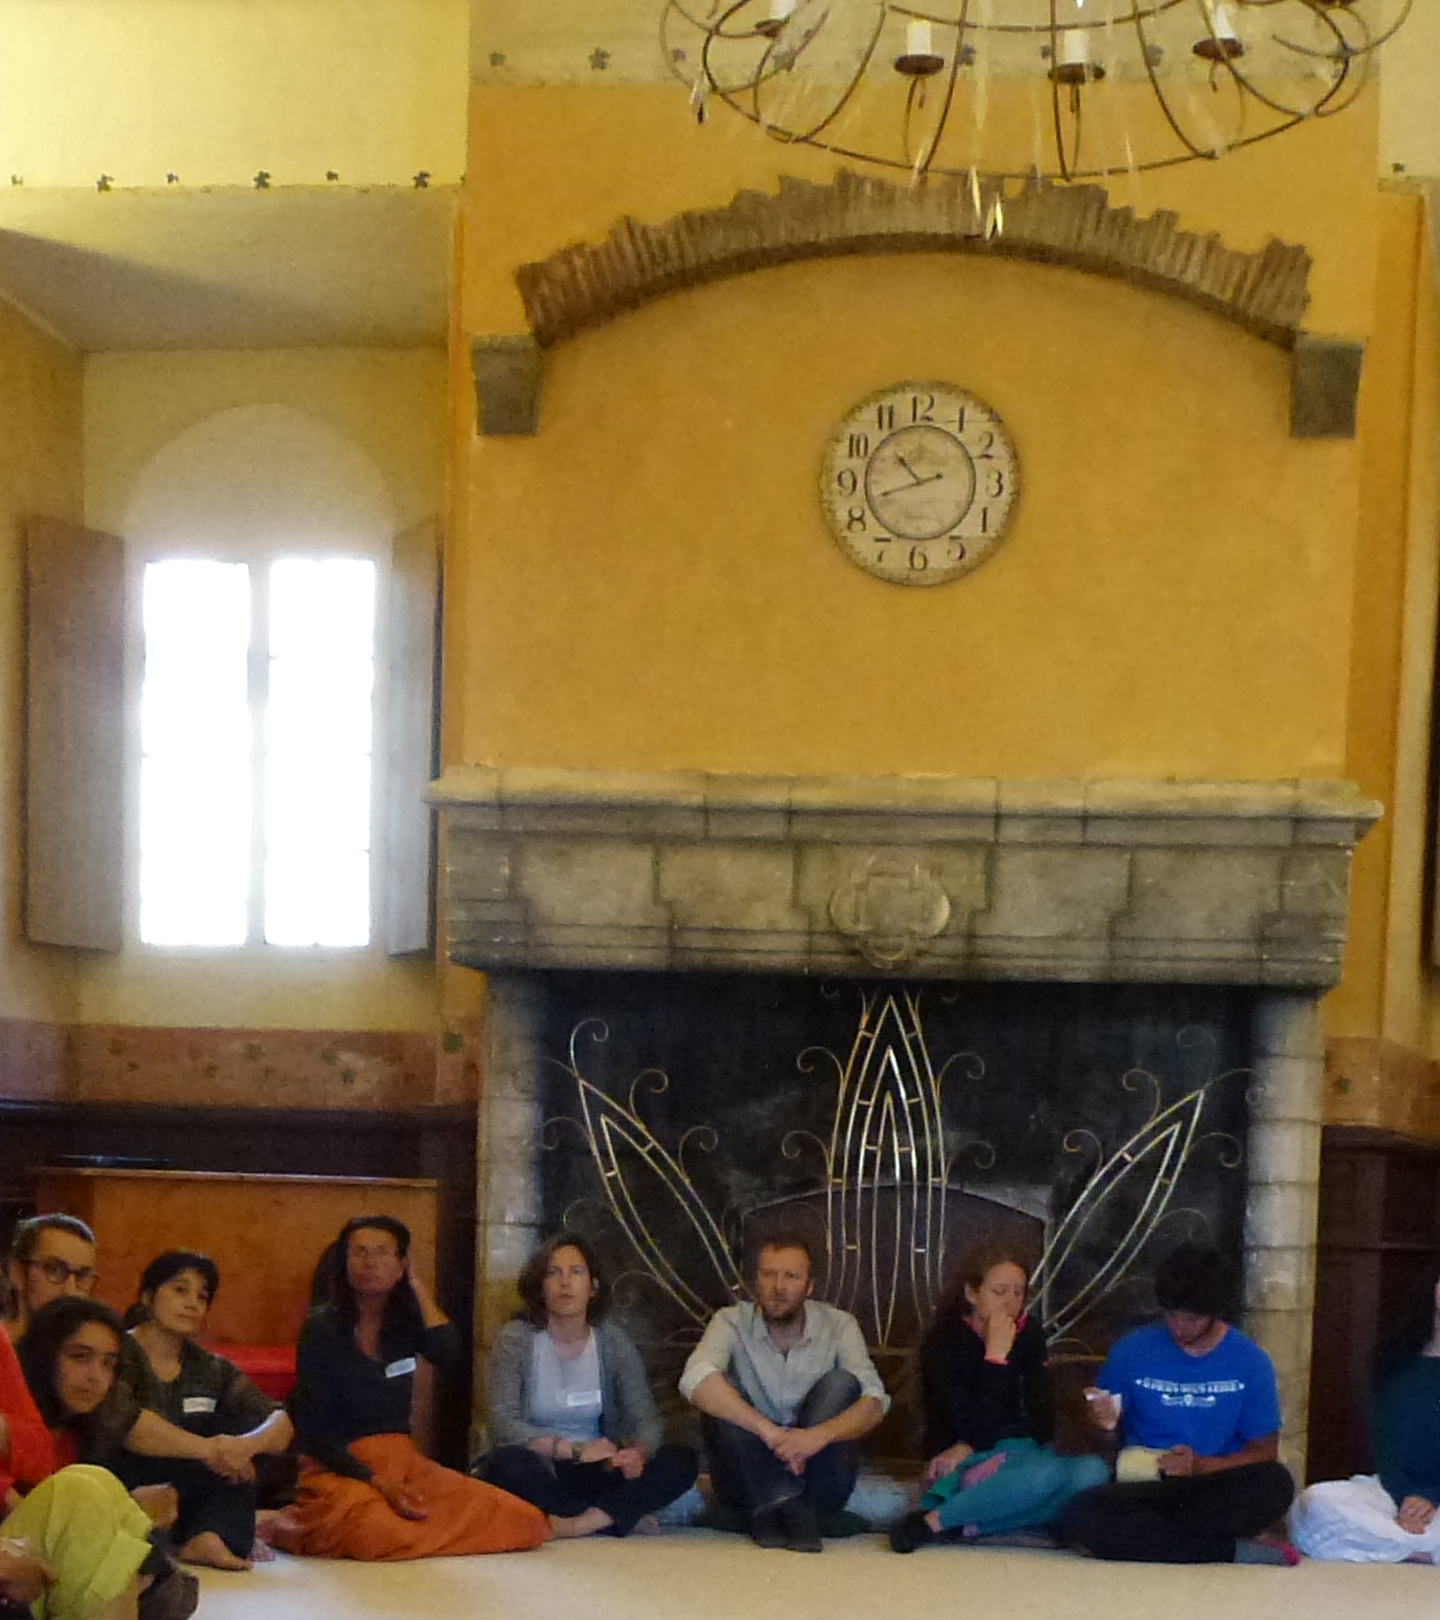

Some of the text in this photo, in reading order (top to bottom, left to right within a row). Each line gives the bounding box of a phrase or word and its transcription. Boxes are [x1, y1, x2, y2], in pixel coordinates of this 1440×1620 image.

[877, 404, 894, 430] 11
[912, 395, 935, 422] 12
[959, 405, 966, 433] 1
[848, 432, 869, 459] 10
[978, 431, 994, 459] 2
[837, 468, 857, 498] 9
[986, 470, 1004, 498] 3
[847, 507, 866, 533] 8
[910, 546, 928, 571] 6
